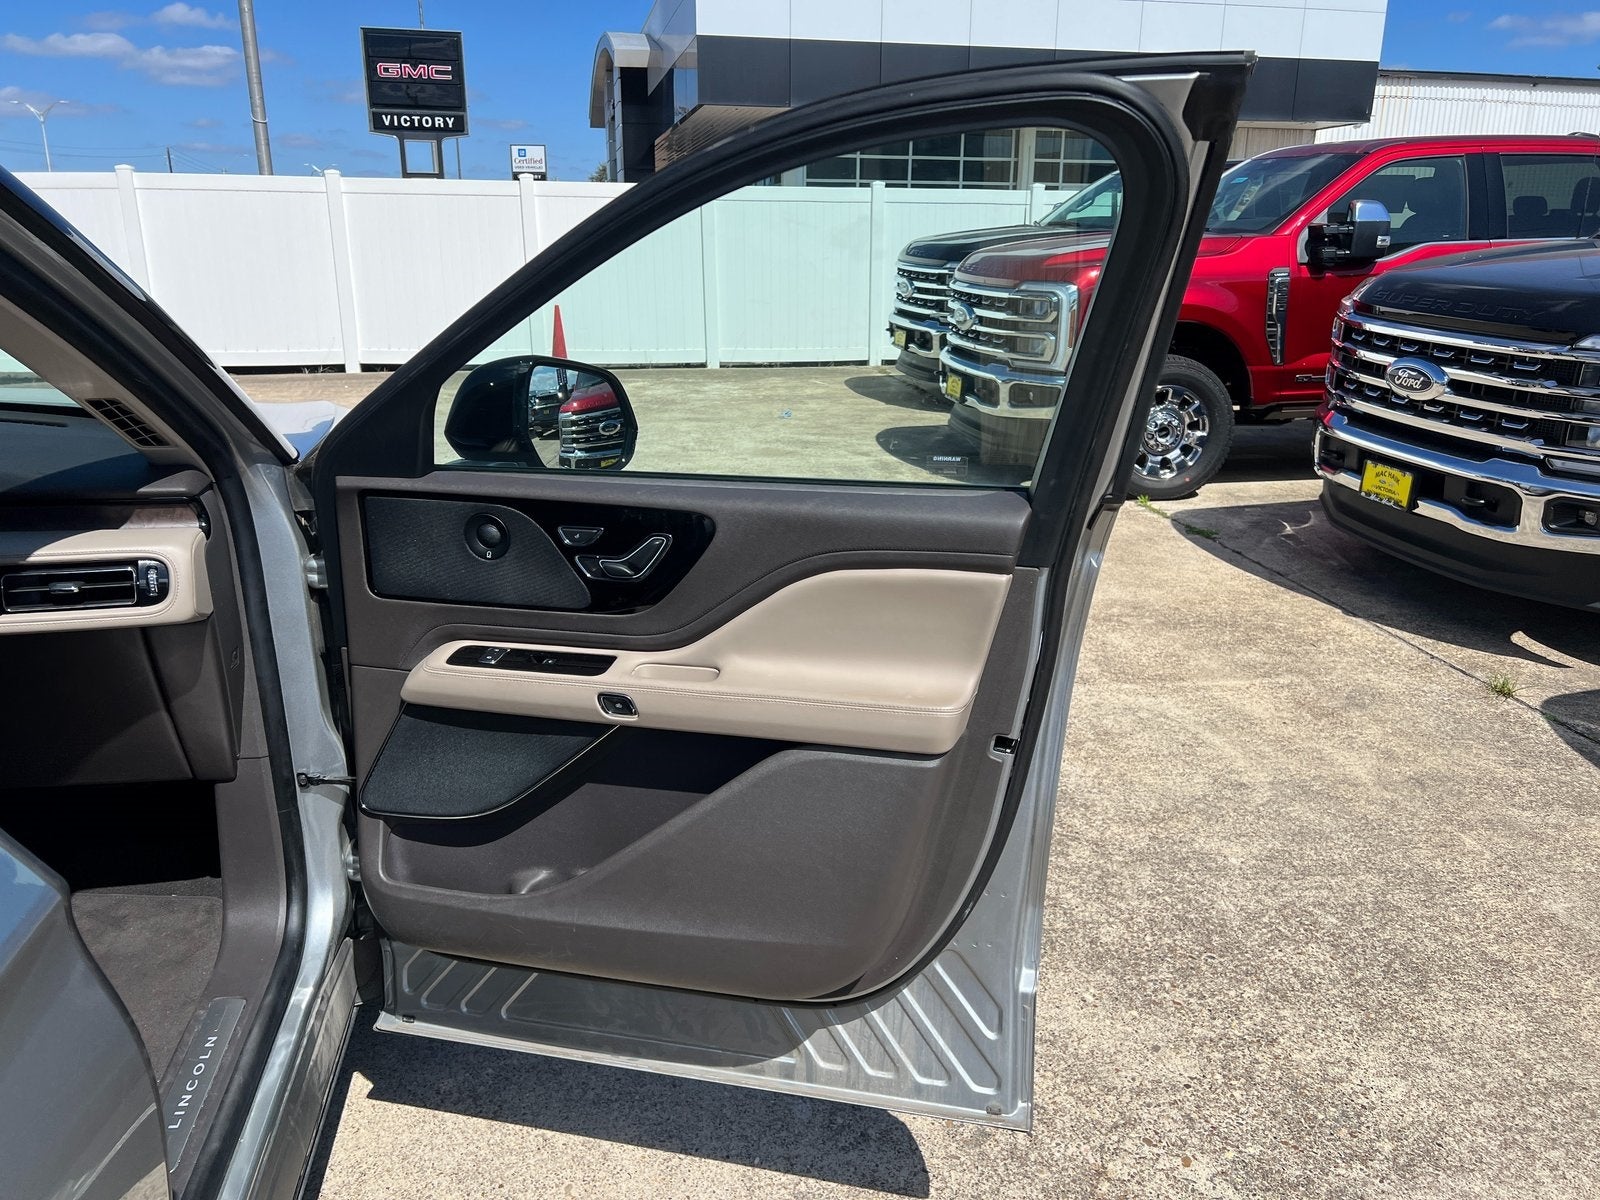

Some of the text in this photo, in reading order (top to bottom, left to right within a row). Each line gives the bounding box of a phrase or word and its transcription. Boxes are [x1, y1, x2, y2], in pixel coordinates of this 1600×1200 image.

[377, 62, 453, 80] GMC
[382, 114, 455, 128] VICTORY
[514, 157, 543, 165] Certified
[1373, 289, 1545, 320] SUPER DUTY
[1394, 368, 1423, 389] Ford
[168, 1036, 218, 1130] LINCOLN
